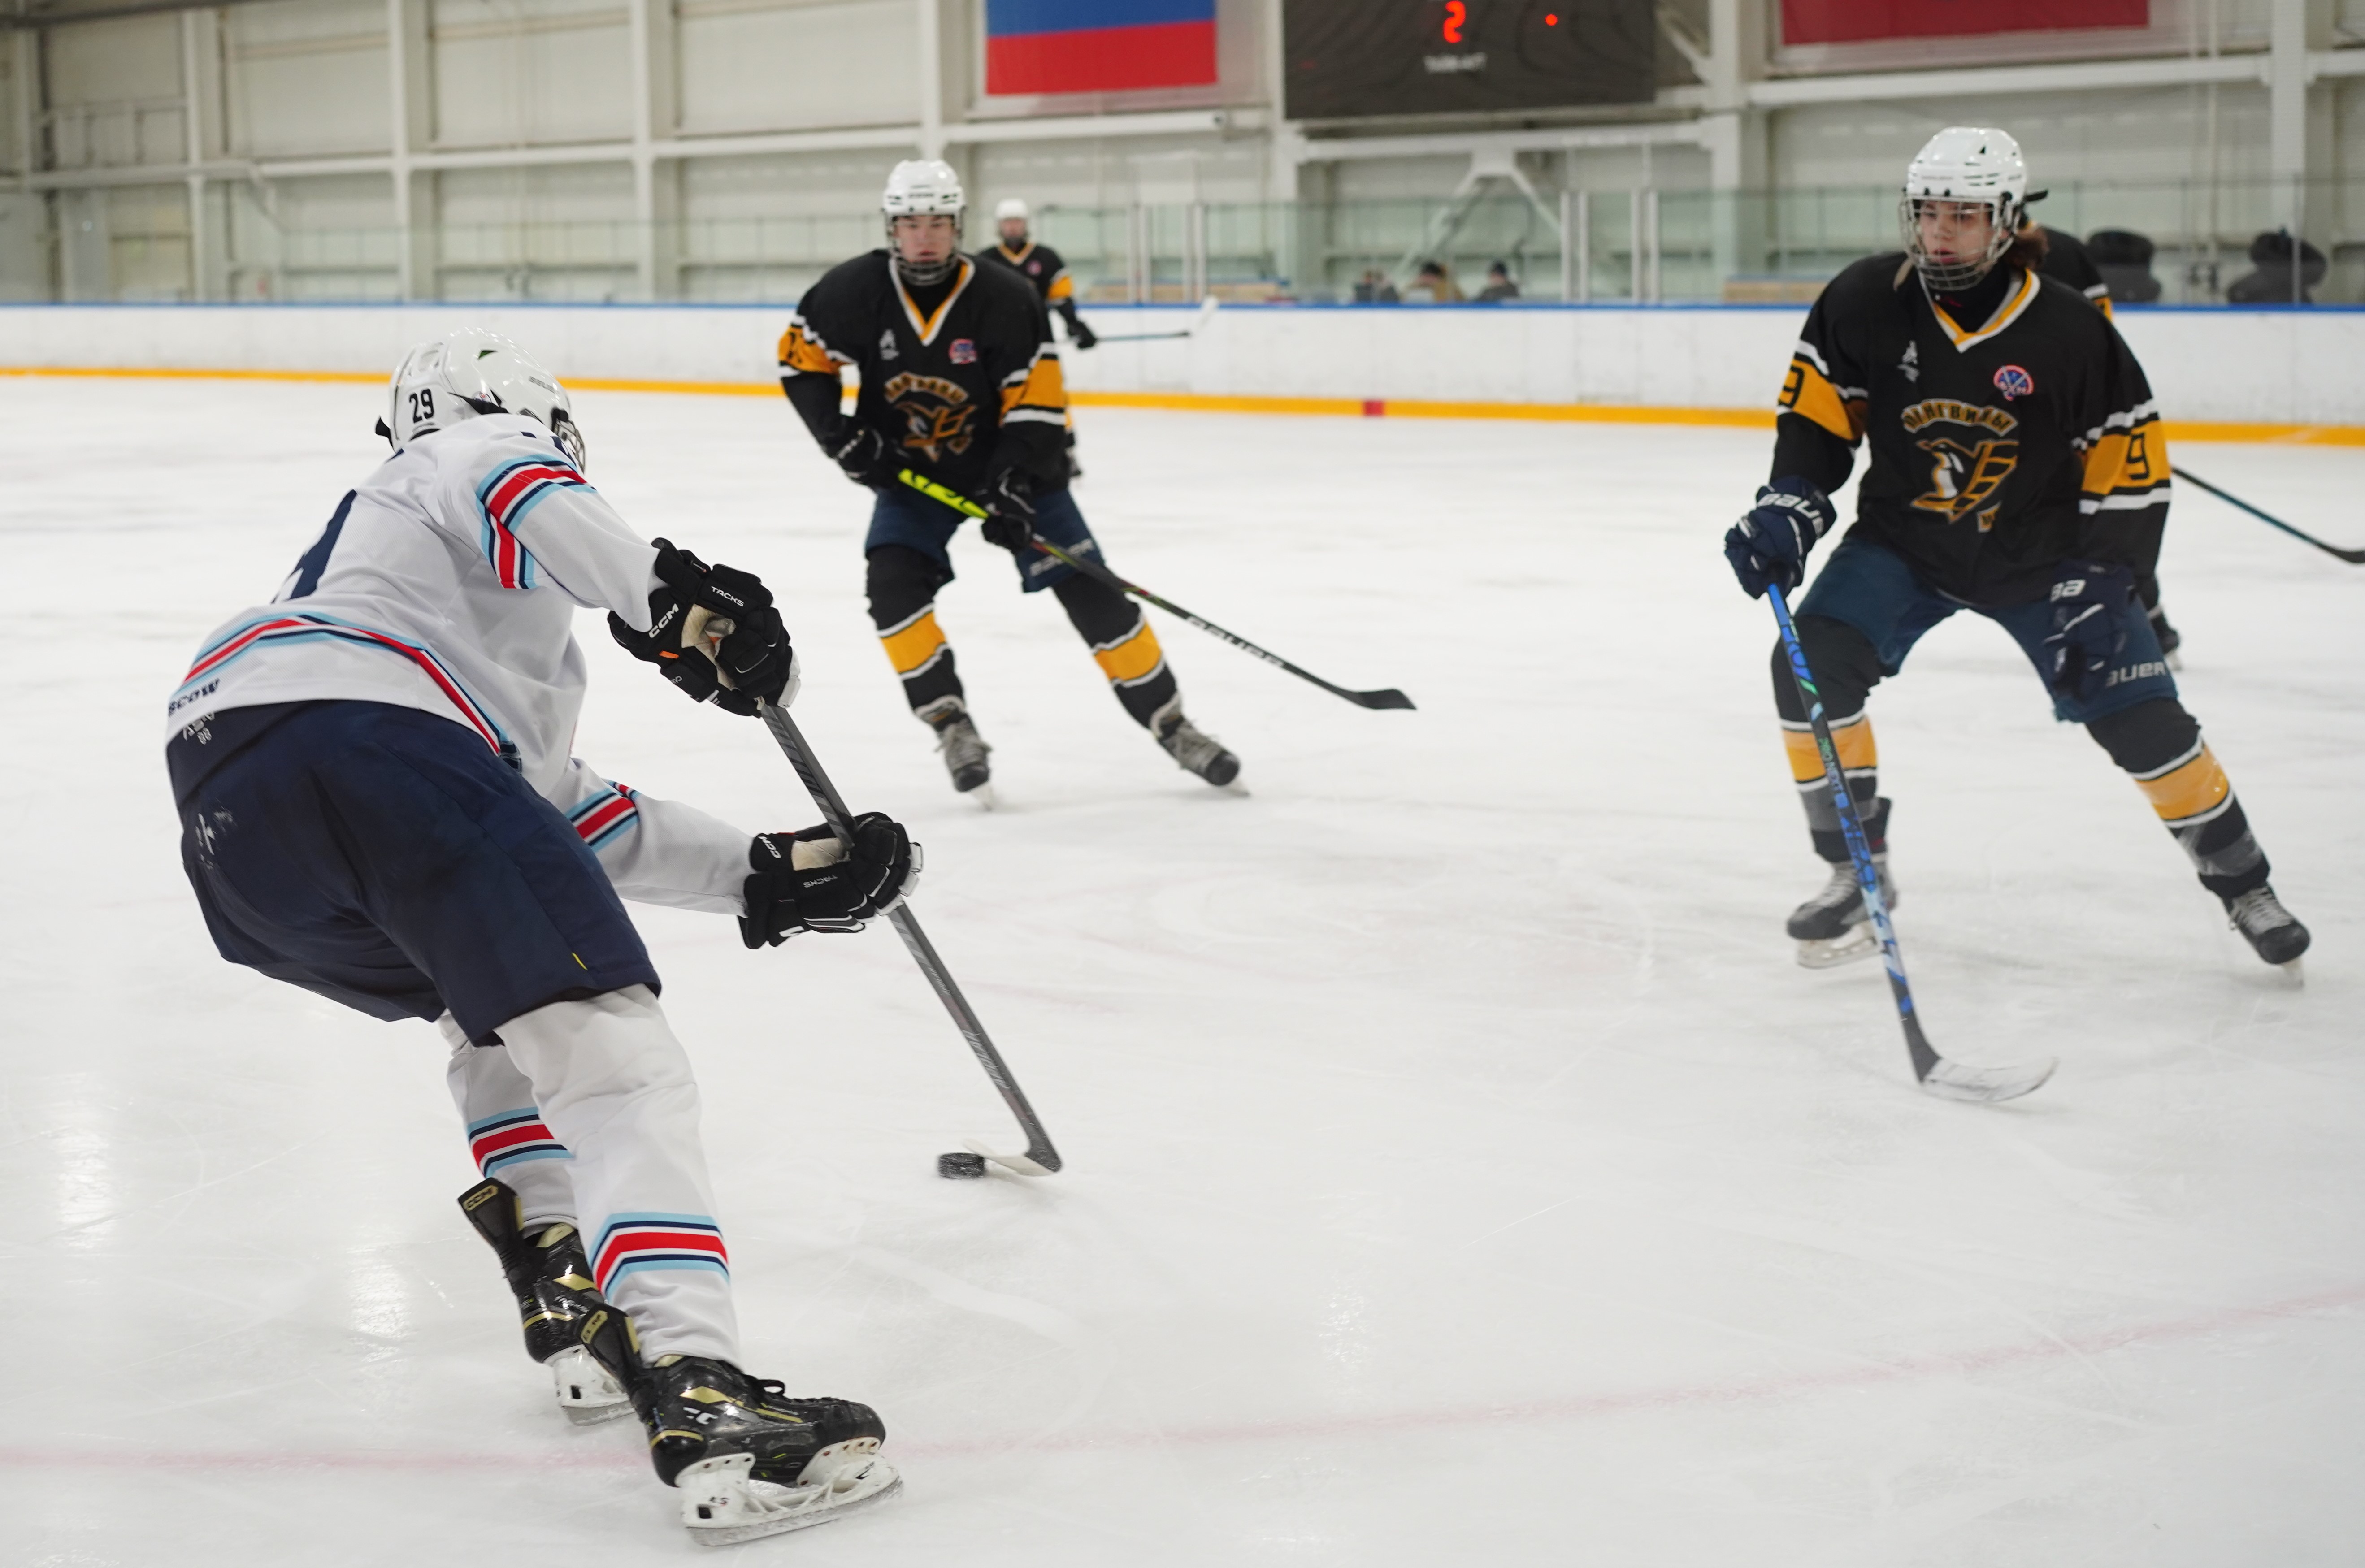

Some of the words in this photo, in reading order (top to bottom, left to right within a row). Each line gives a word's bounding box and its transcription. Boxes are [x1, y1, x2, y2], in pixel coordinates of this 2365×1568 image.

[1443, 0, 1466, 43] 2
[409, 388, 434, 423] 29
[2126, 432, 2150, 480] 9
[711, 585, 745, 607] TACKS
[648, 603, 679, 638] CCM
[758, 836, 781, 858] CCM
[803, 874, 838, 888] TACKS
